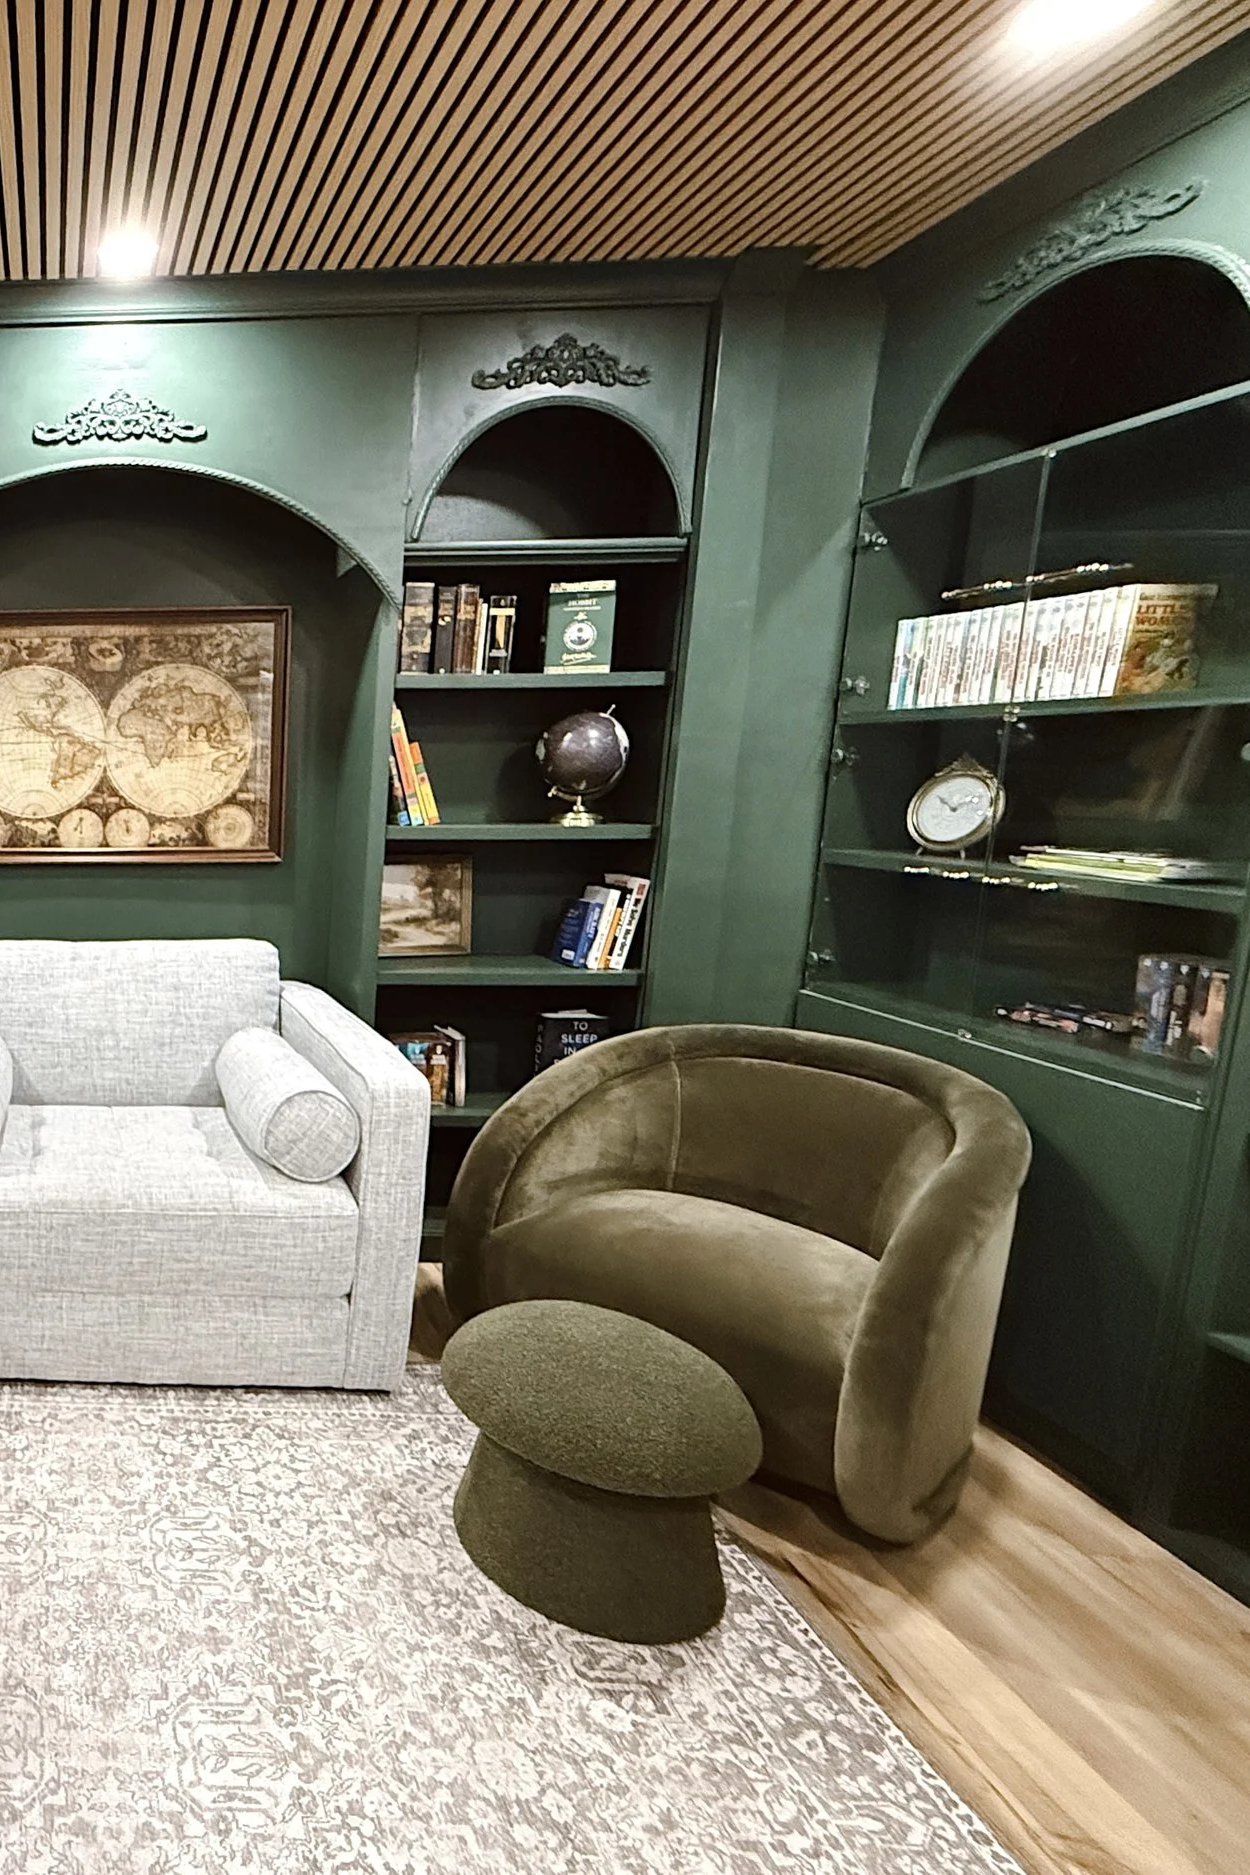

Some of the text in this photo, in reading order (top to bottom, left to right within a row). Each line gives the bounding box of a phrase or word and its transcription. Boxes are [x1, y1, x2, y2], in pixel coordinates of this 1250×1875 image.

[617, 928, 631, 957] Murders
[573, 1021, 588, 1031] TO
[561, 1033, 598, 1044] SLEEP
